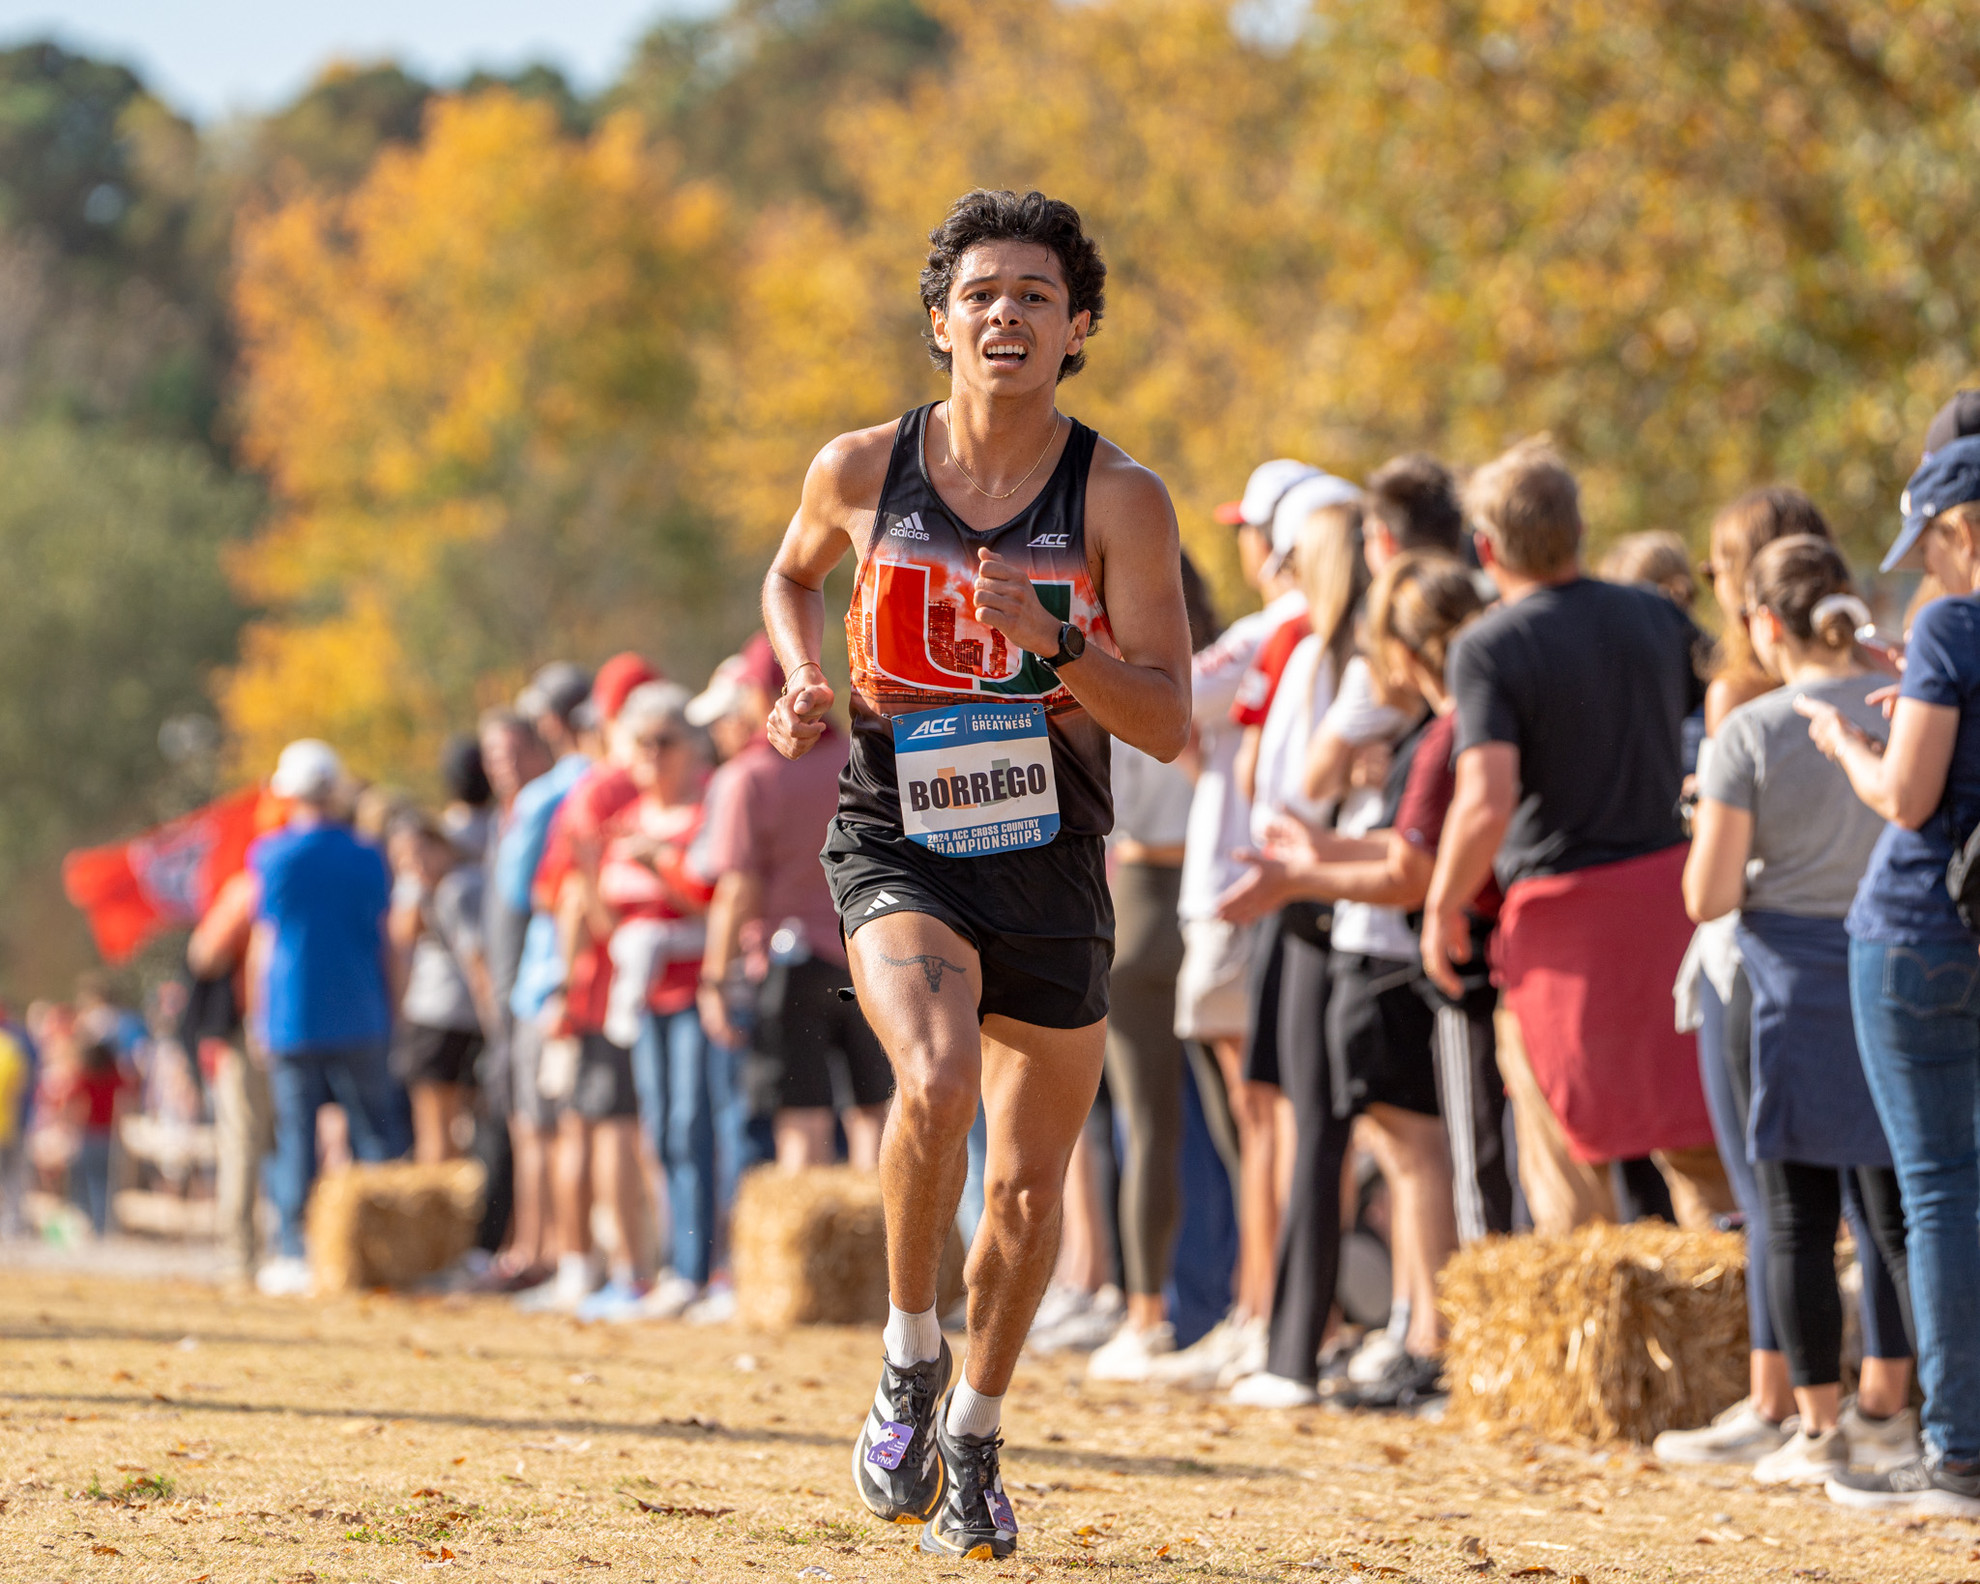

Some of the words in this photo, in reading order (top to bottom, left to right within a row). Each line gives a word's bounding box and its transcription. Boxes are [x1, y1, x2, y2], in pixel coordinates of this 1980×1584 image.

[889, 526, 930, 542] adidas
[1029, 533, 1070, 546] ACC
[909, 716, 958, 738] ACC
[971, 718, 1032, 732] GREATNESS
[908, 763, 1047, 812] BORREGO
[926, 832, 950, 844] 2024
[952, 830, 969, 841] ACC
[971, 825, 999, 837] CROSS
[1001, 818, 1039, 833] COUNTRY
[926, 828, 1042, 854] CHAMPIONSHIPS
[869, 1450, 894, 1467] LYNX
